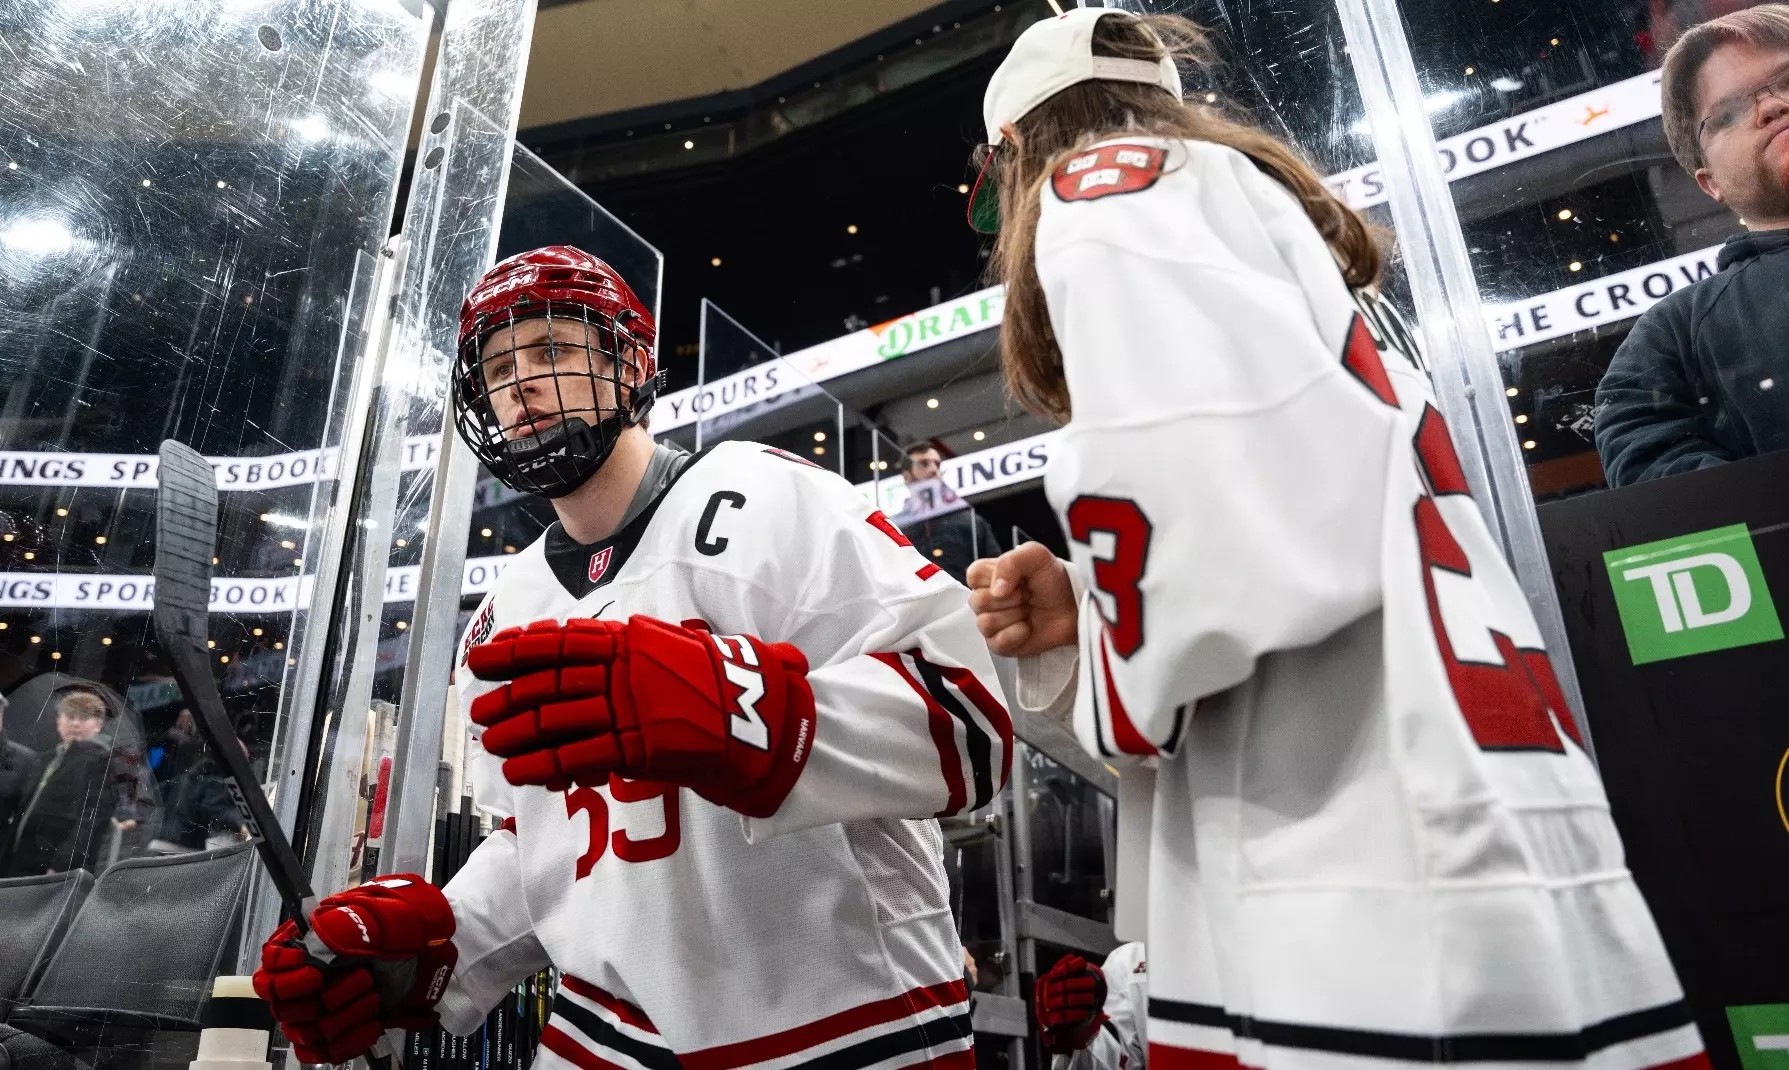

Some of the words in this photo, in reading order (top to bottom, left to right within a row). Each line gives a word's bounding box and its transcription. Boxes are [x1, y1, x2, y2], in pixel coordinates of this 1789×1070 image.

[475, 272, 537, 303] CCM
[1575, 261, 1715, 318] CROW
[670, 367, 778, 419] YOURS
[694, 490, 746, 556] C
[592, 551, 607, 574] H
[76, 582, 288, 605] SPORBOOK
[1623, 552, 1752, 634] TD
[793, 718, 810, 763] HARVARD
[227, 783, 261, 838] CCM
[337, 906, 370, 943] CCM
[430, 965, 448, 1000] CCM
